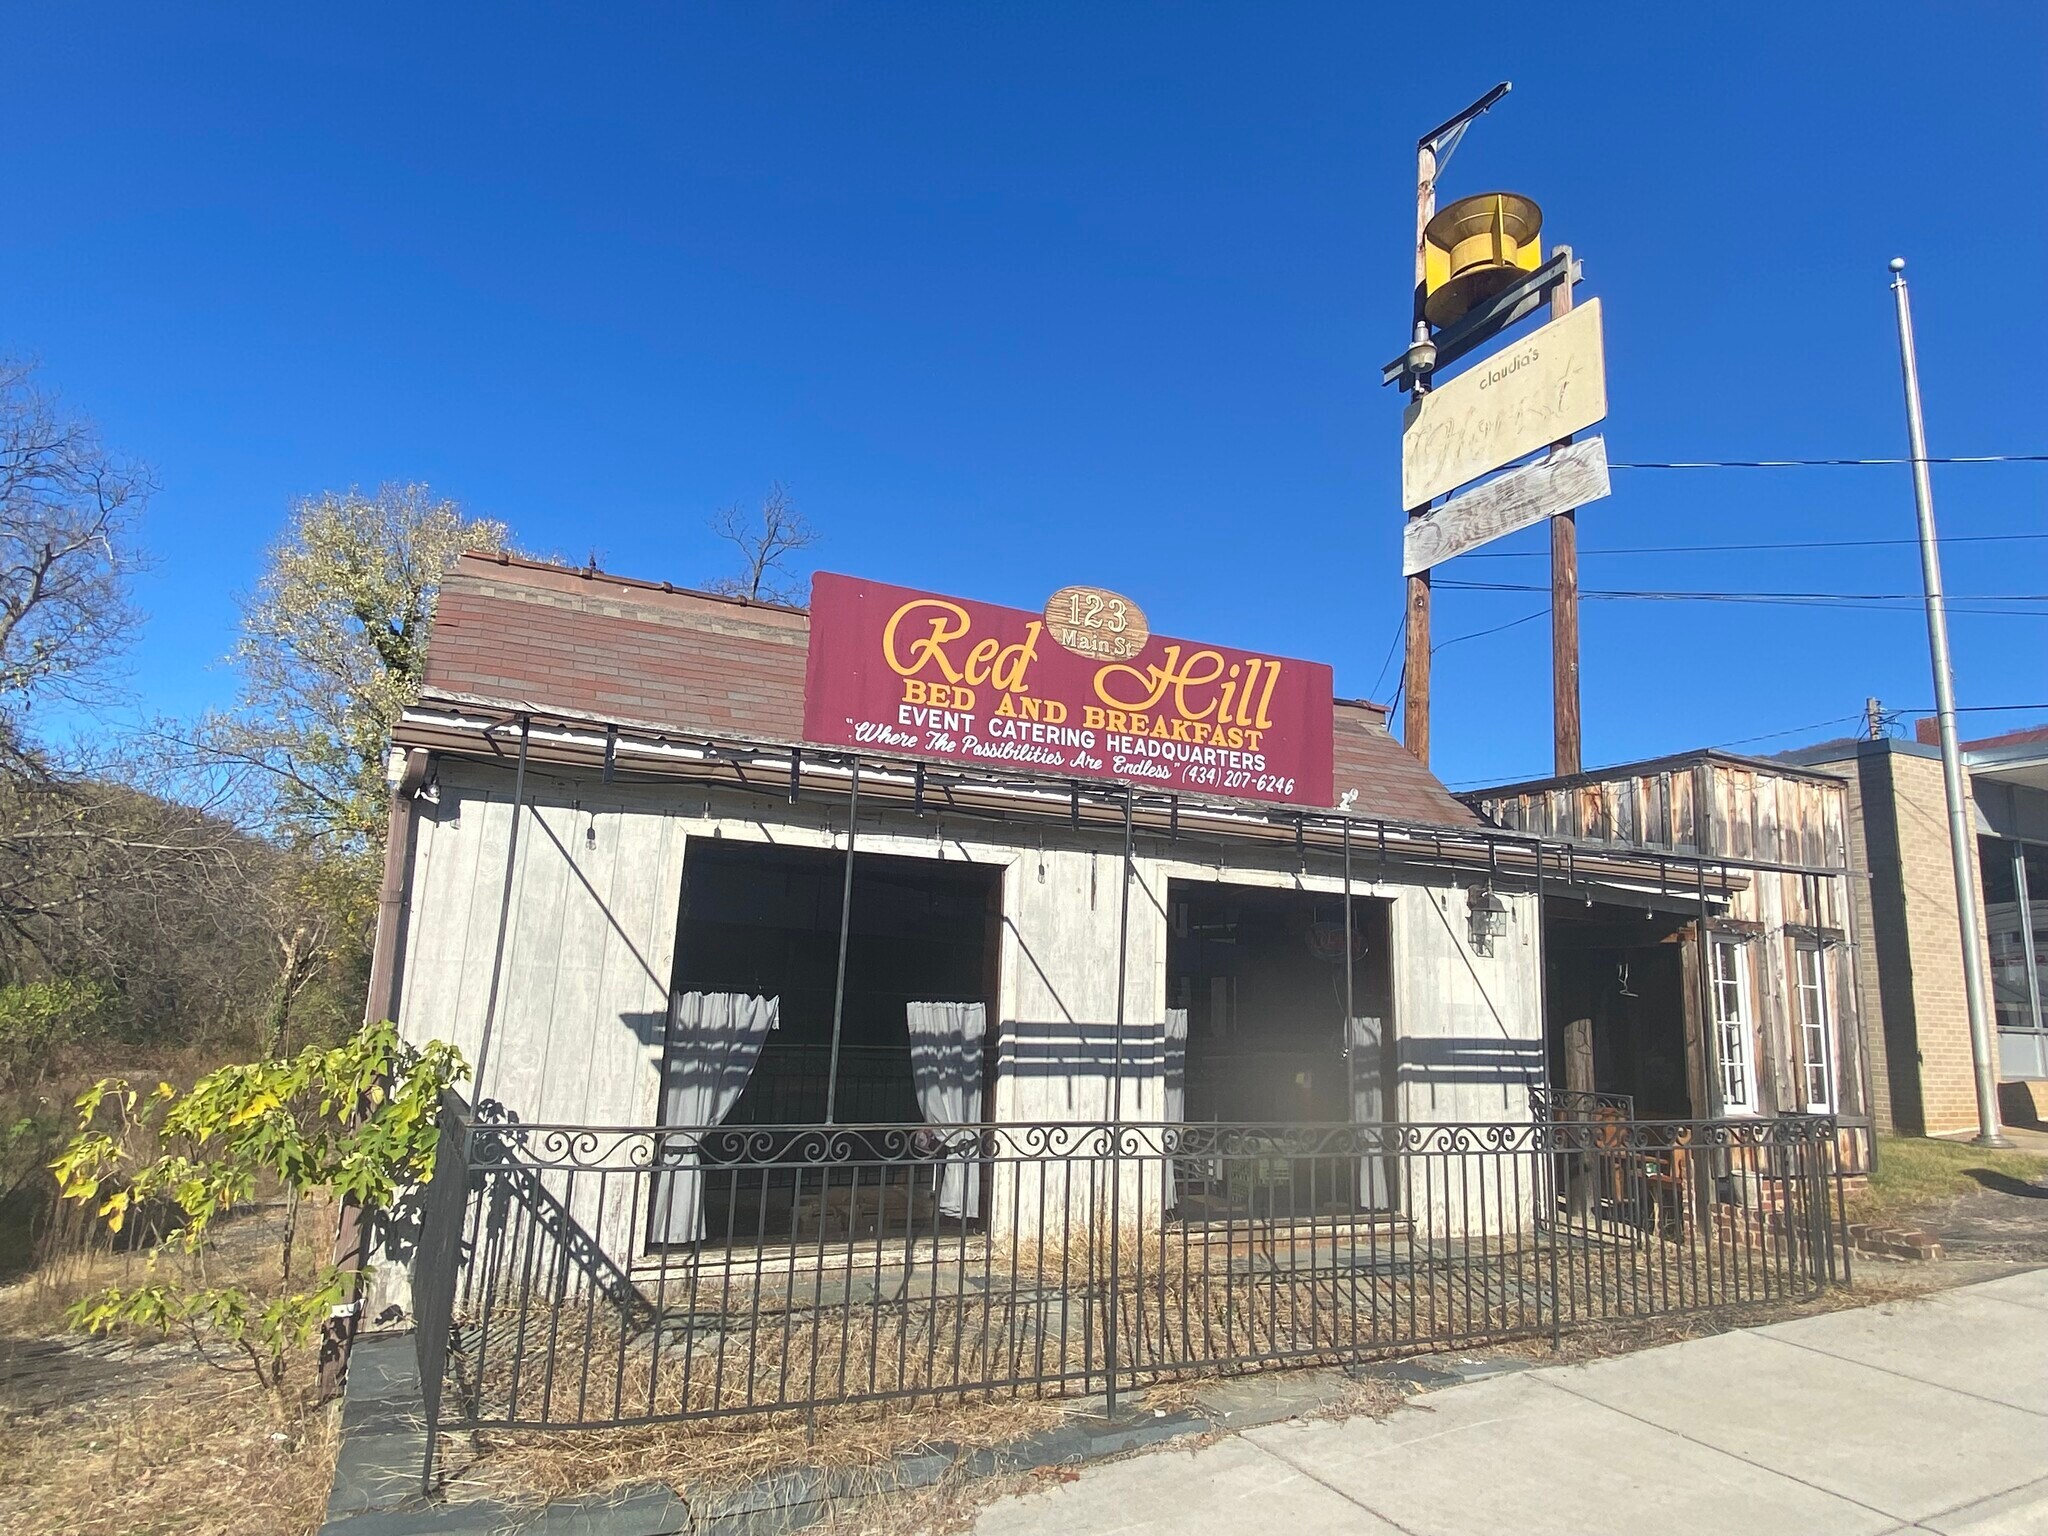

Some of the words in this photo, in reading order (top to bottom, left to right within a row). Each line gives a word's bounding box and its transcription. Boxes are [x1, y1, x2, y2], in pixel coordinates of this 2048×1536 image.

[1480, 348, 1539, 390] claudia's
[1061, 627, 1111, 653] Main
[1068, 593, 1128, 633] 123
[883, 599, 1043, 693] Red
[1093, 645, 1281, 730] Hill
[898, 704, 976, 733] EVENT
[988, 717, 1096, 749] CATERING
[1106, 733, 1267, 772] HEADQUARTERS
[902, 678, 976, 711] BED
[994, 692, 1068, 724] AND
[1083, 705, 1264, 752] BREAKFAST
[924, 730, 957, 753] The
[1069, 750, 1103, 770] Are
[1181, 763, 1222, 788] (434)
[1223, 768, 1296, 797] 207-6246
